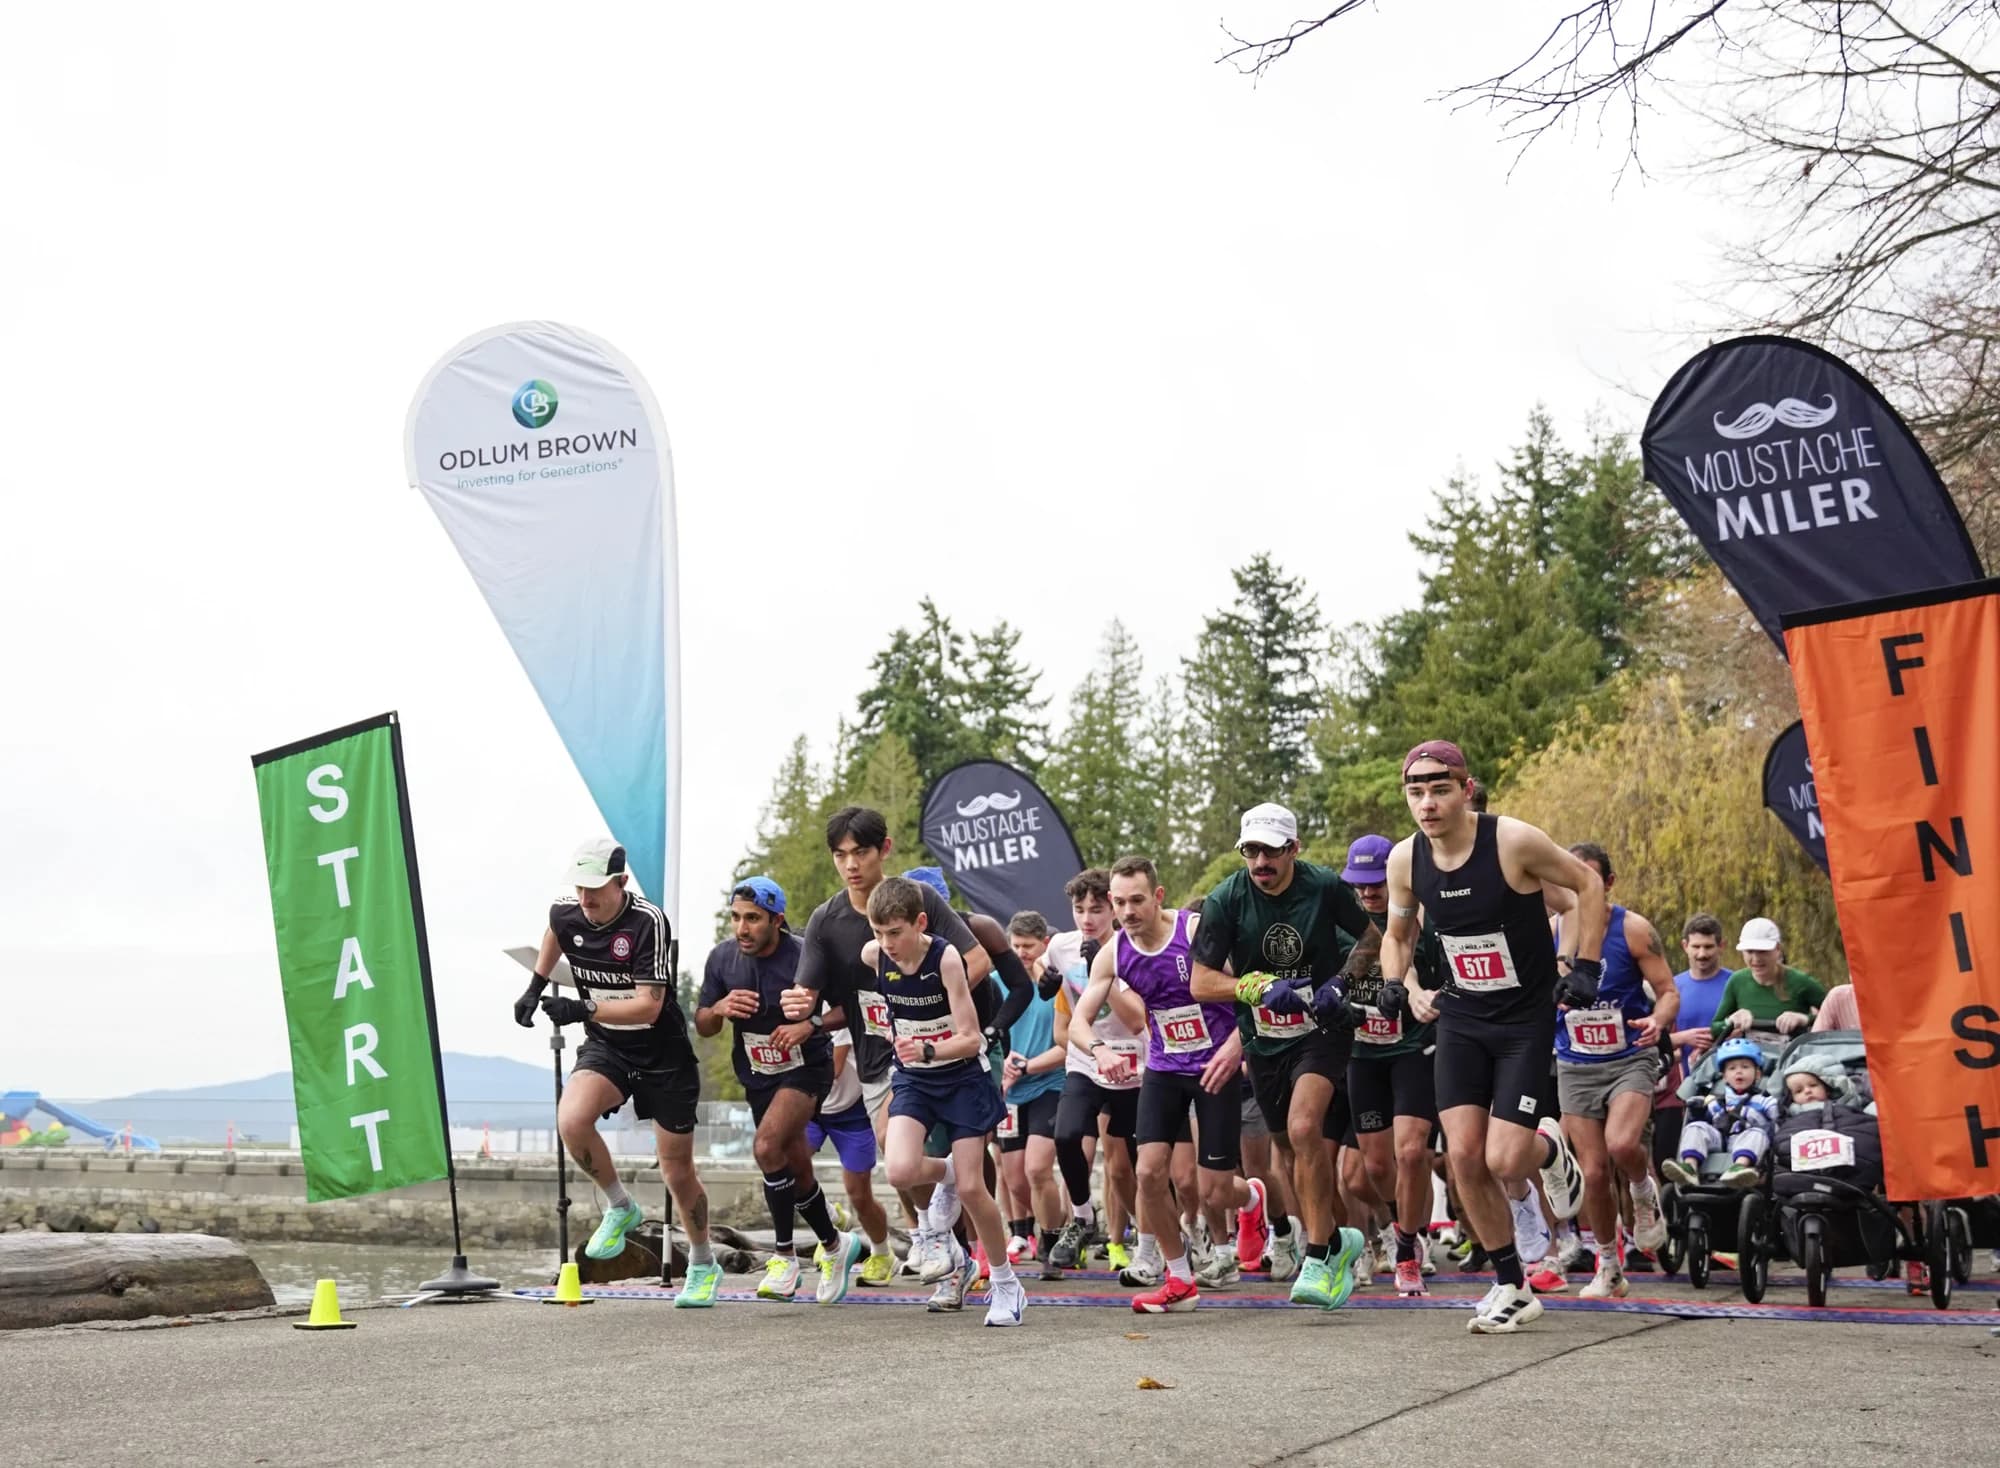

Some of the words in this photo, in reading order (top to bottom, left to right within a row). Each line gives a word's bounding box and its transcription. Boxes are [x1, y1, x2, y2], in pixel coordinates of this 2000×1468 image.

[439, 442, 529, 472] ODLUM
[537, 427, 637, 459] BROWN
[1684, 426, 1881, 495] MOUSTACHE
[457, 472, 515, 489] Investing
[517, 469, 536, 482] for
[1716, 477, 1879, 542] MILER
[940, 806, 1043, 847] MOUSTACHE
[954, 834, 1040, 872] MILER
[306, 763, 390, 1172] START
[1462, 956, 1491, 978] 517
[886, 993, 944, 1006] THUNDERBIRDS
[1170, 1021, 1197, 1041] 146
[1366, 1020, 1391, 1034] 142
[1581, 1026, 1609, 1044] 514
[757, 1048, 783, 1063] 199
[1807, 1139, 1832, 1158] 214
